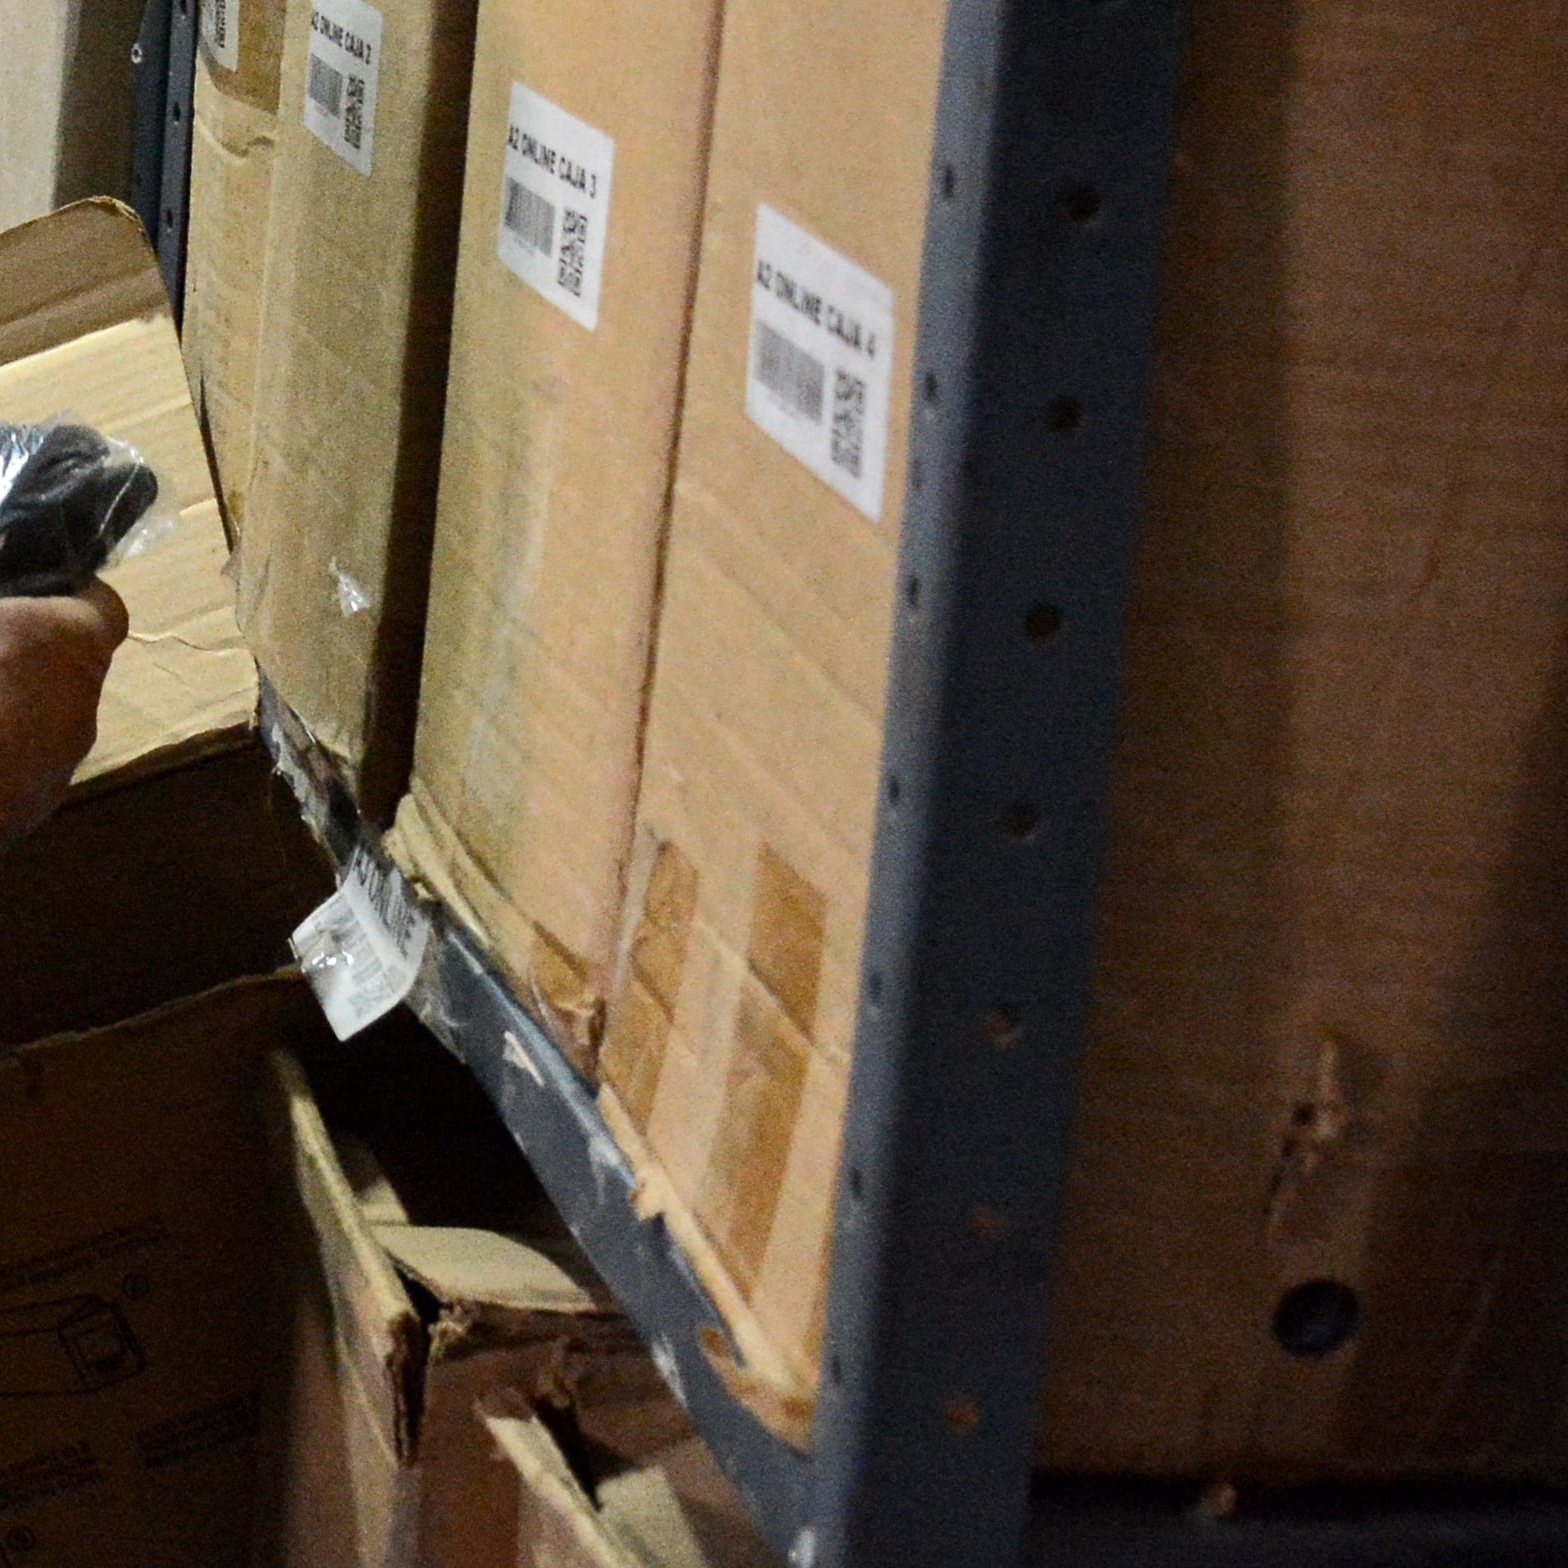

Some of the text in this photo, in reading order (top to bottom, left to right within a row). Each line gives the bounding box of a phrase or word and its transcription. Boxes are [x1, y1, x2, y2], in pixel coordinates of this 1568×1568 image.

[344, 32, 364, 59] CAJA
[365, 41, 372, 66] 2
[522, 133, 556, 175] ONLINE
[559, 156, 586, 191] CAJA
[589, 173, 597, 199] 3
[775, 270, 822, 326] ONLINE
[827, 304, 862, 350] CAJA
